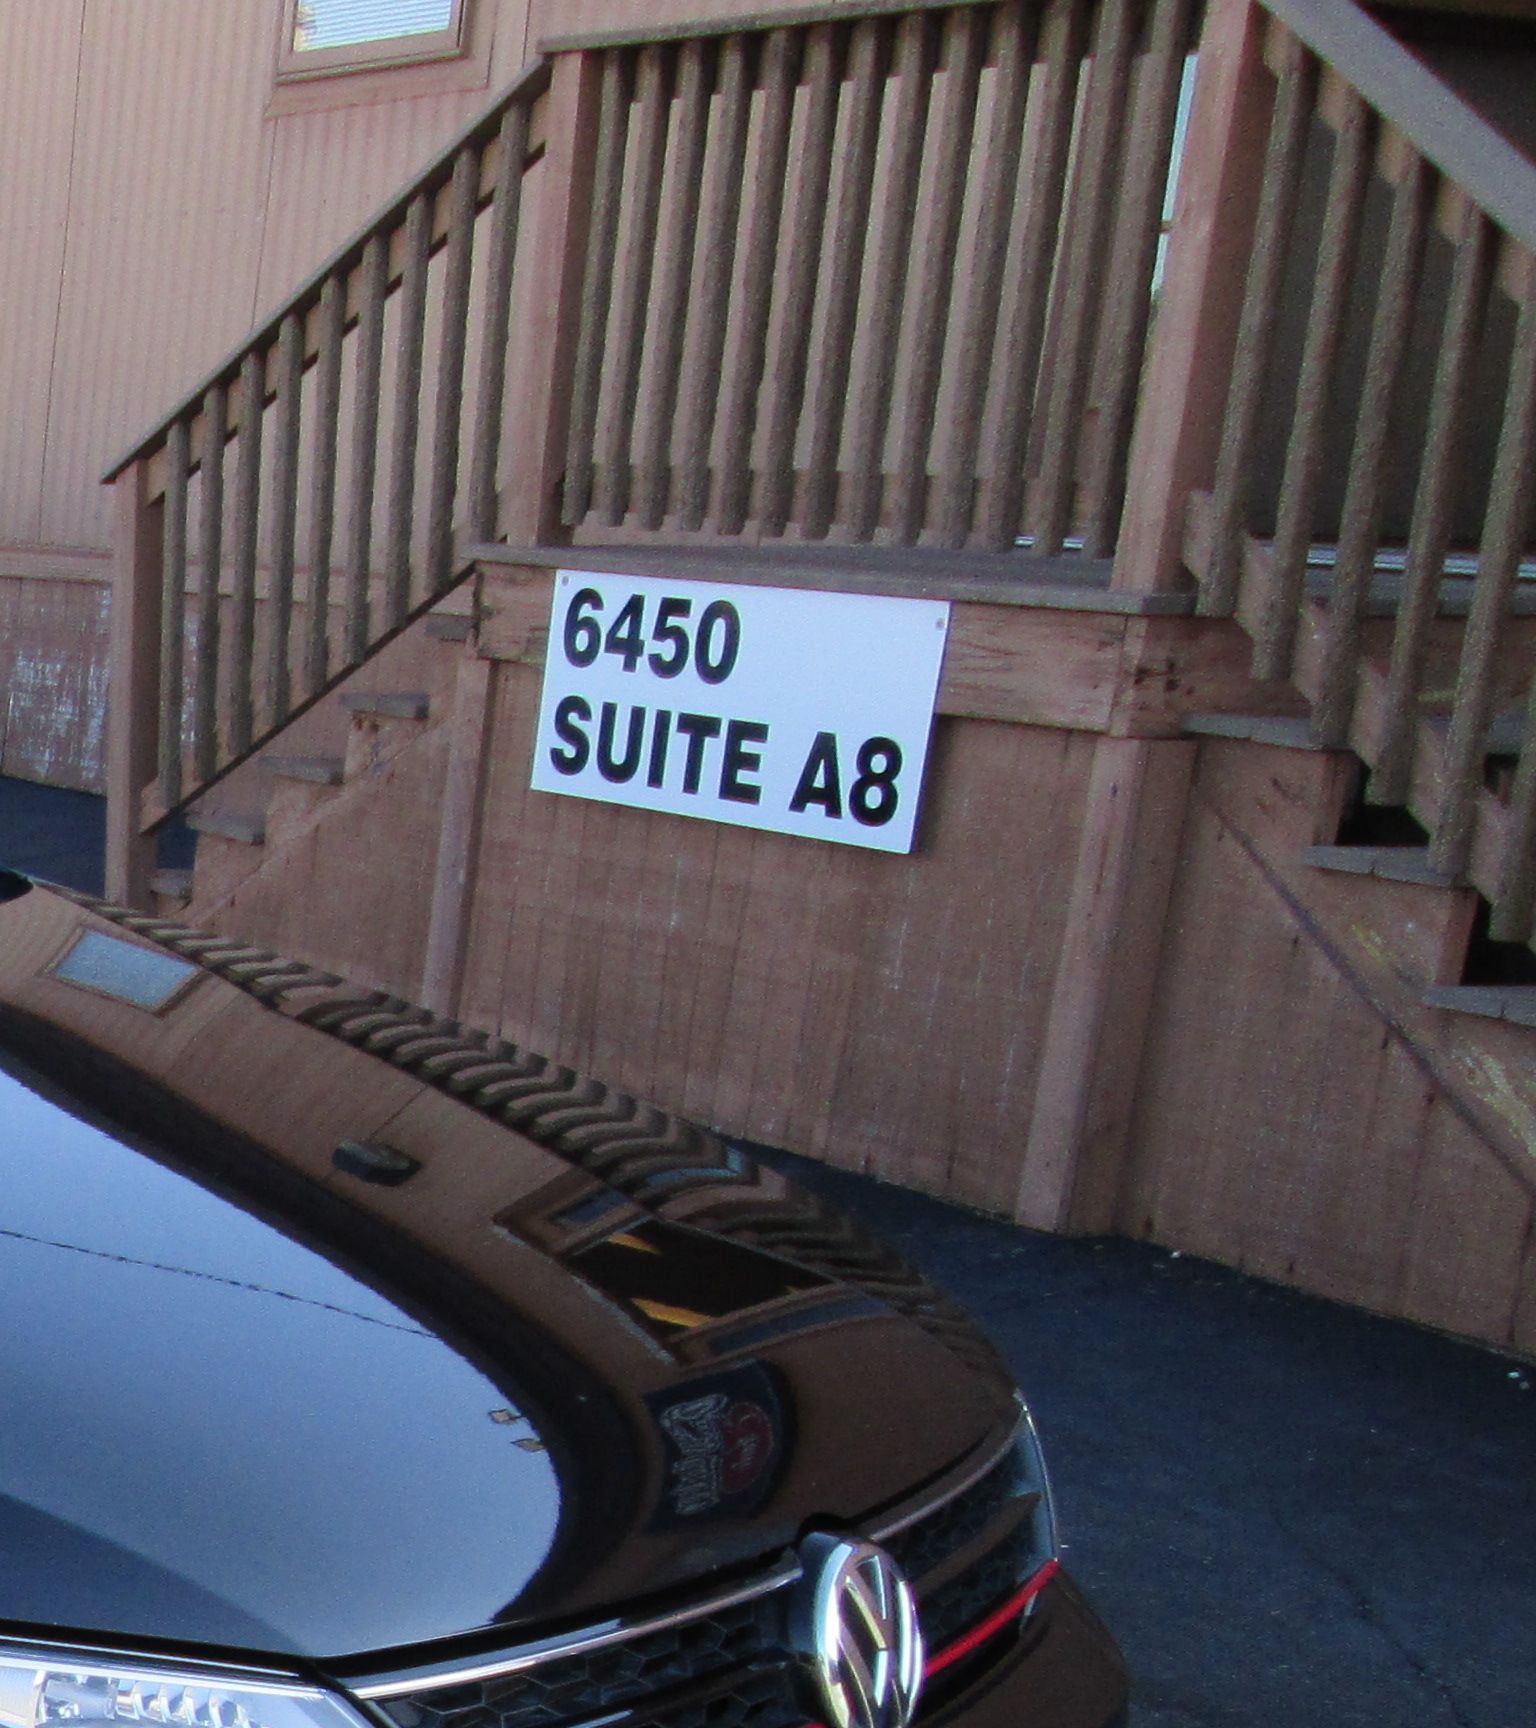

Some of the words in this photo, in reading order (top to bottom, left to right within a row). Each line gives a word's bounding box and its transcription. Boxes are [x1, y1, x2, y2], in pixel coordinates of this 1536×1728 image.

[563, 587, 742, 685] 6450
[549, 694, 770, 806] SUITE
[788, 730, 904, 828] A8
